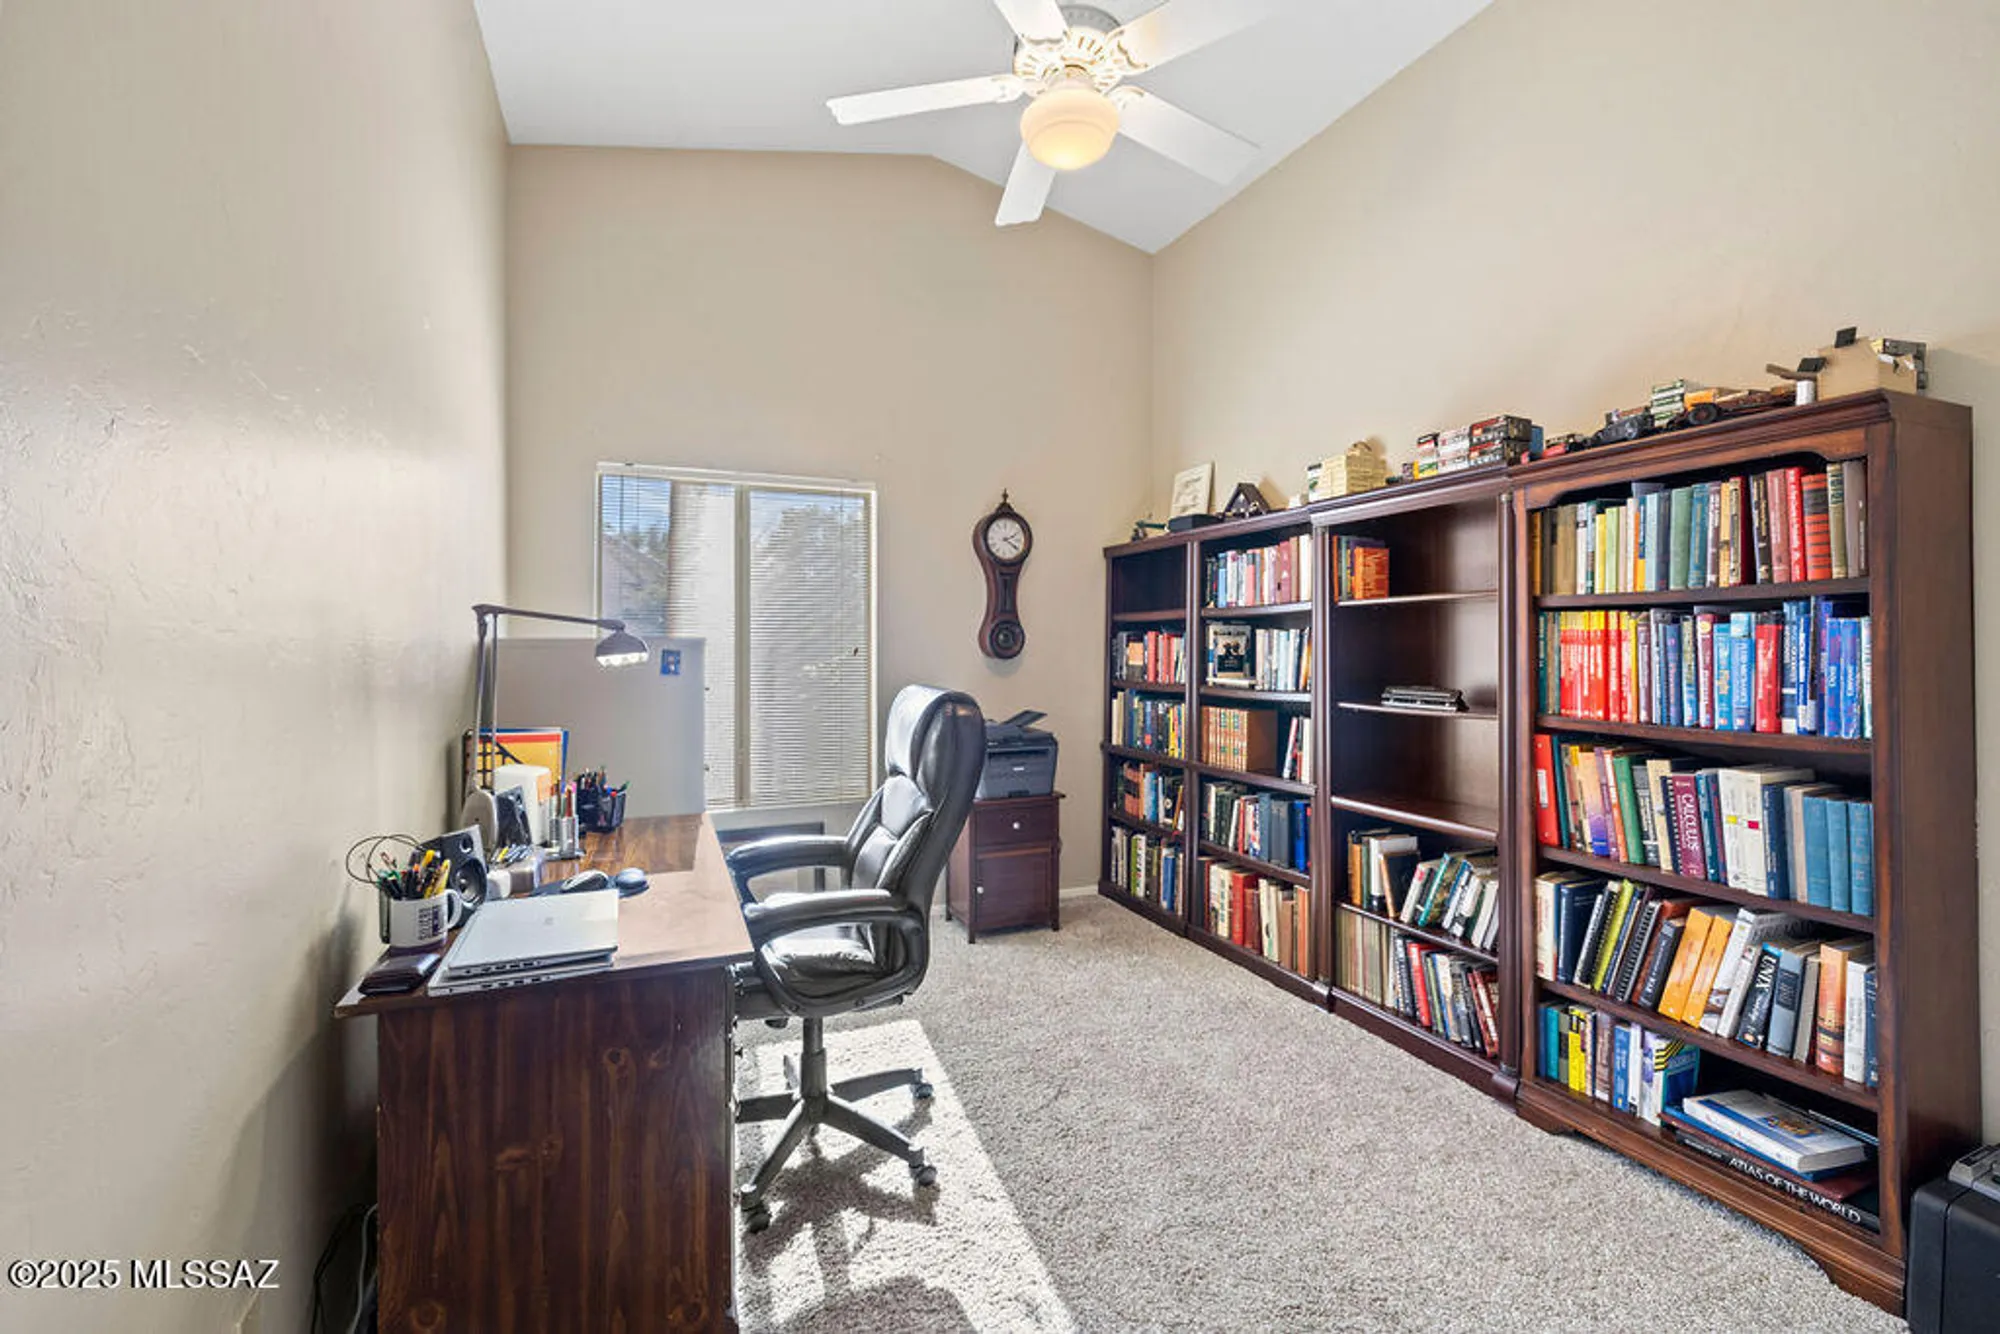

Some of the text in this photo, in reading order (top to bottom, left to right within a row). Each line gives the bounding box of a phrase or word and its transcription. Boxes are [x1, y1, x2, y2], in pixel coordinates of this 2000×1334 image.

[1755, 955, 1777, 992] UNIX
[1729, 1158, 1861, 1222] ATLAS OF THE WORLD
